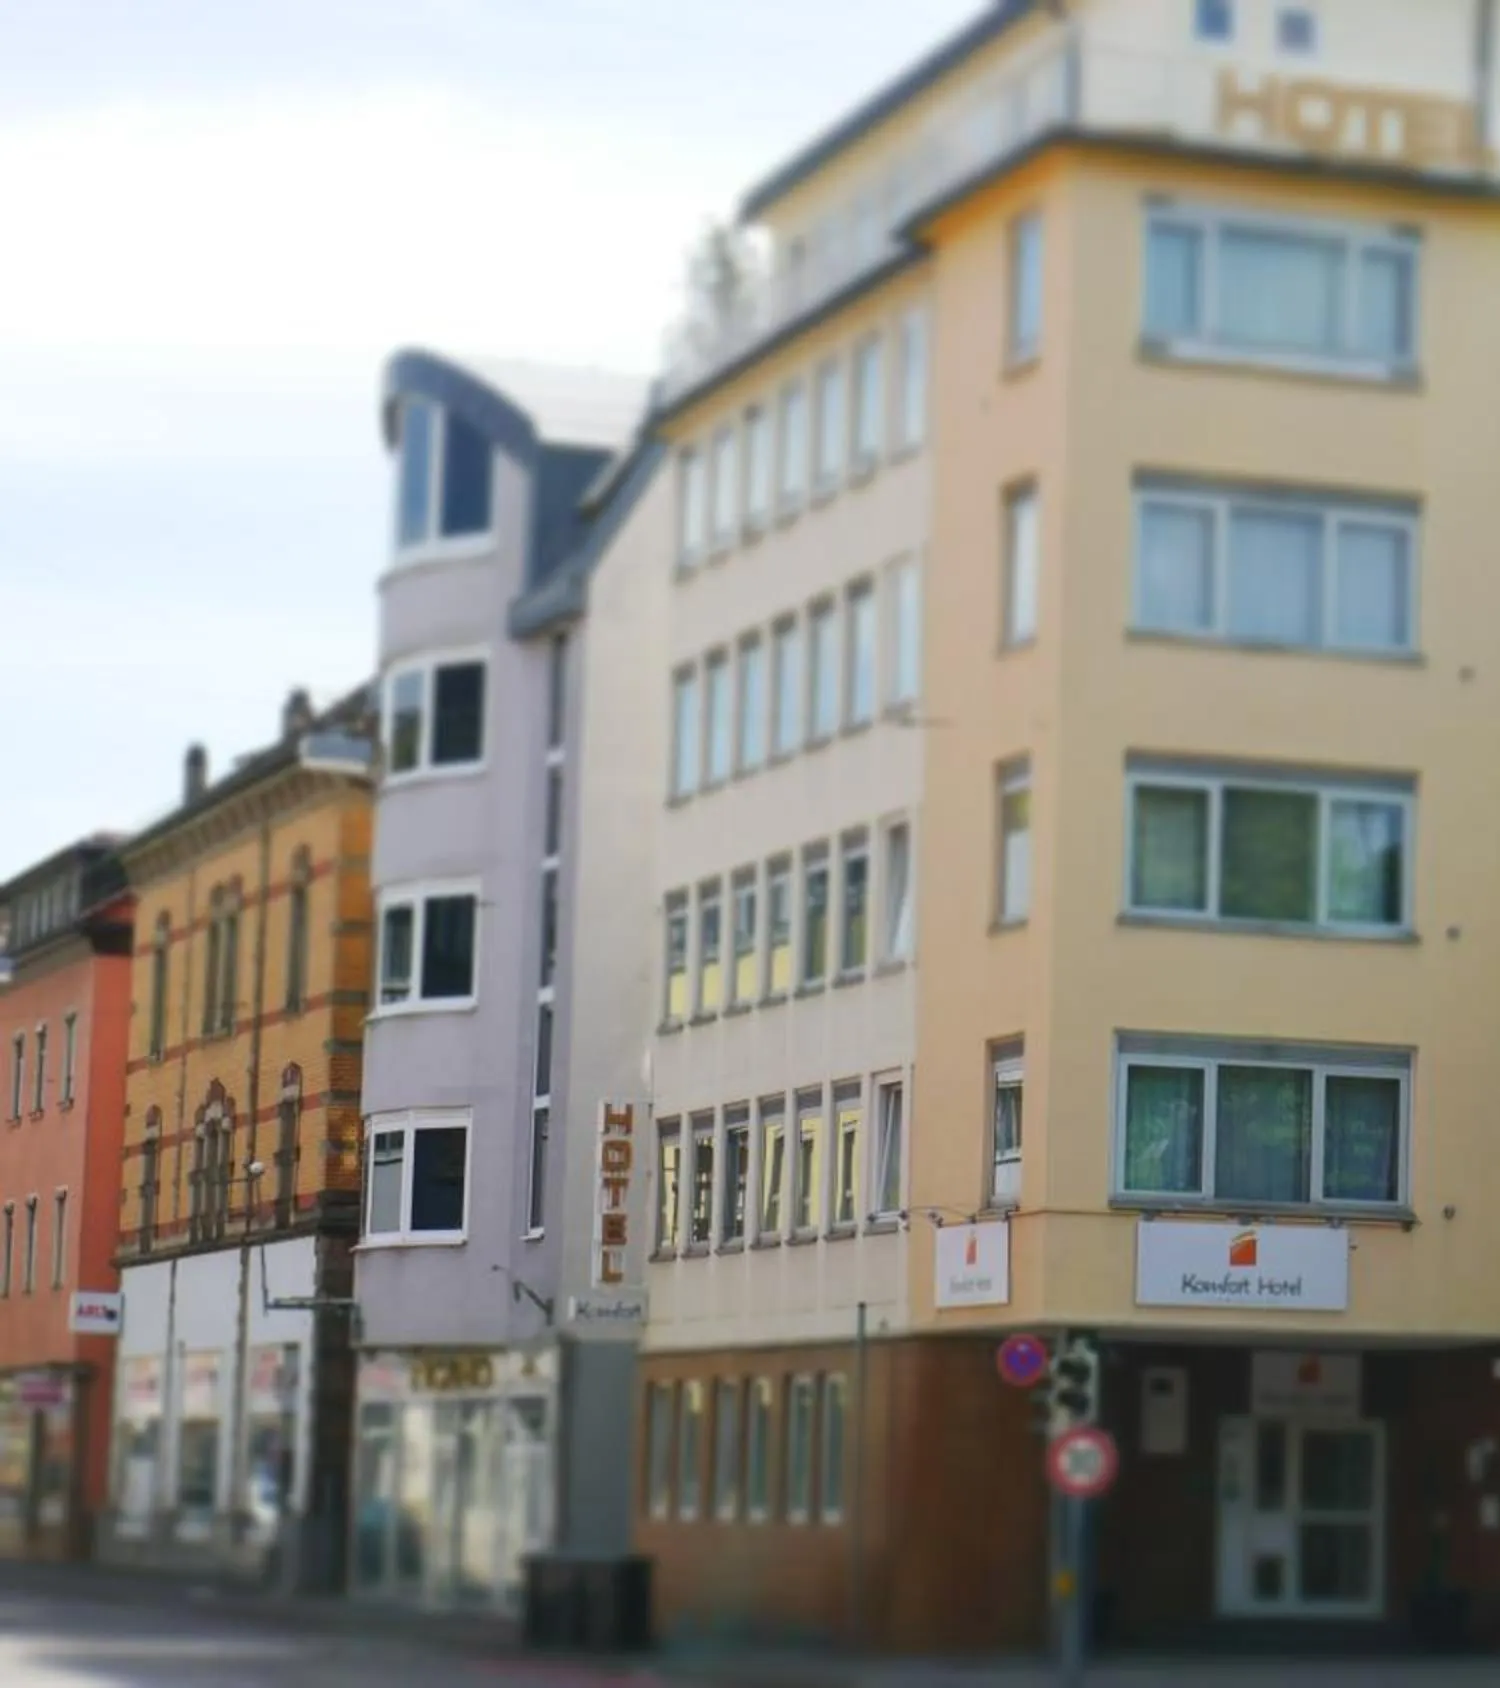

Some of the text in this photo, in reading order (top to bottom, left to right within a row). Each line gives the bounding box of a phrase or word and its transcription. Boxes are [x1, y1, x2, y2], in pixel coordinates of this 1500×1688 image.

[602, 1103, 633, 1283] HOTEL
[1182, 1272, 1302, 1302] Komfort Hotel
